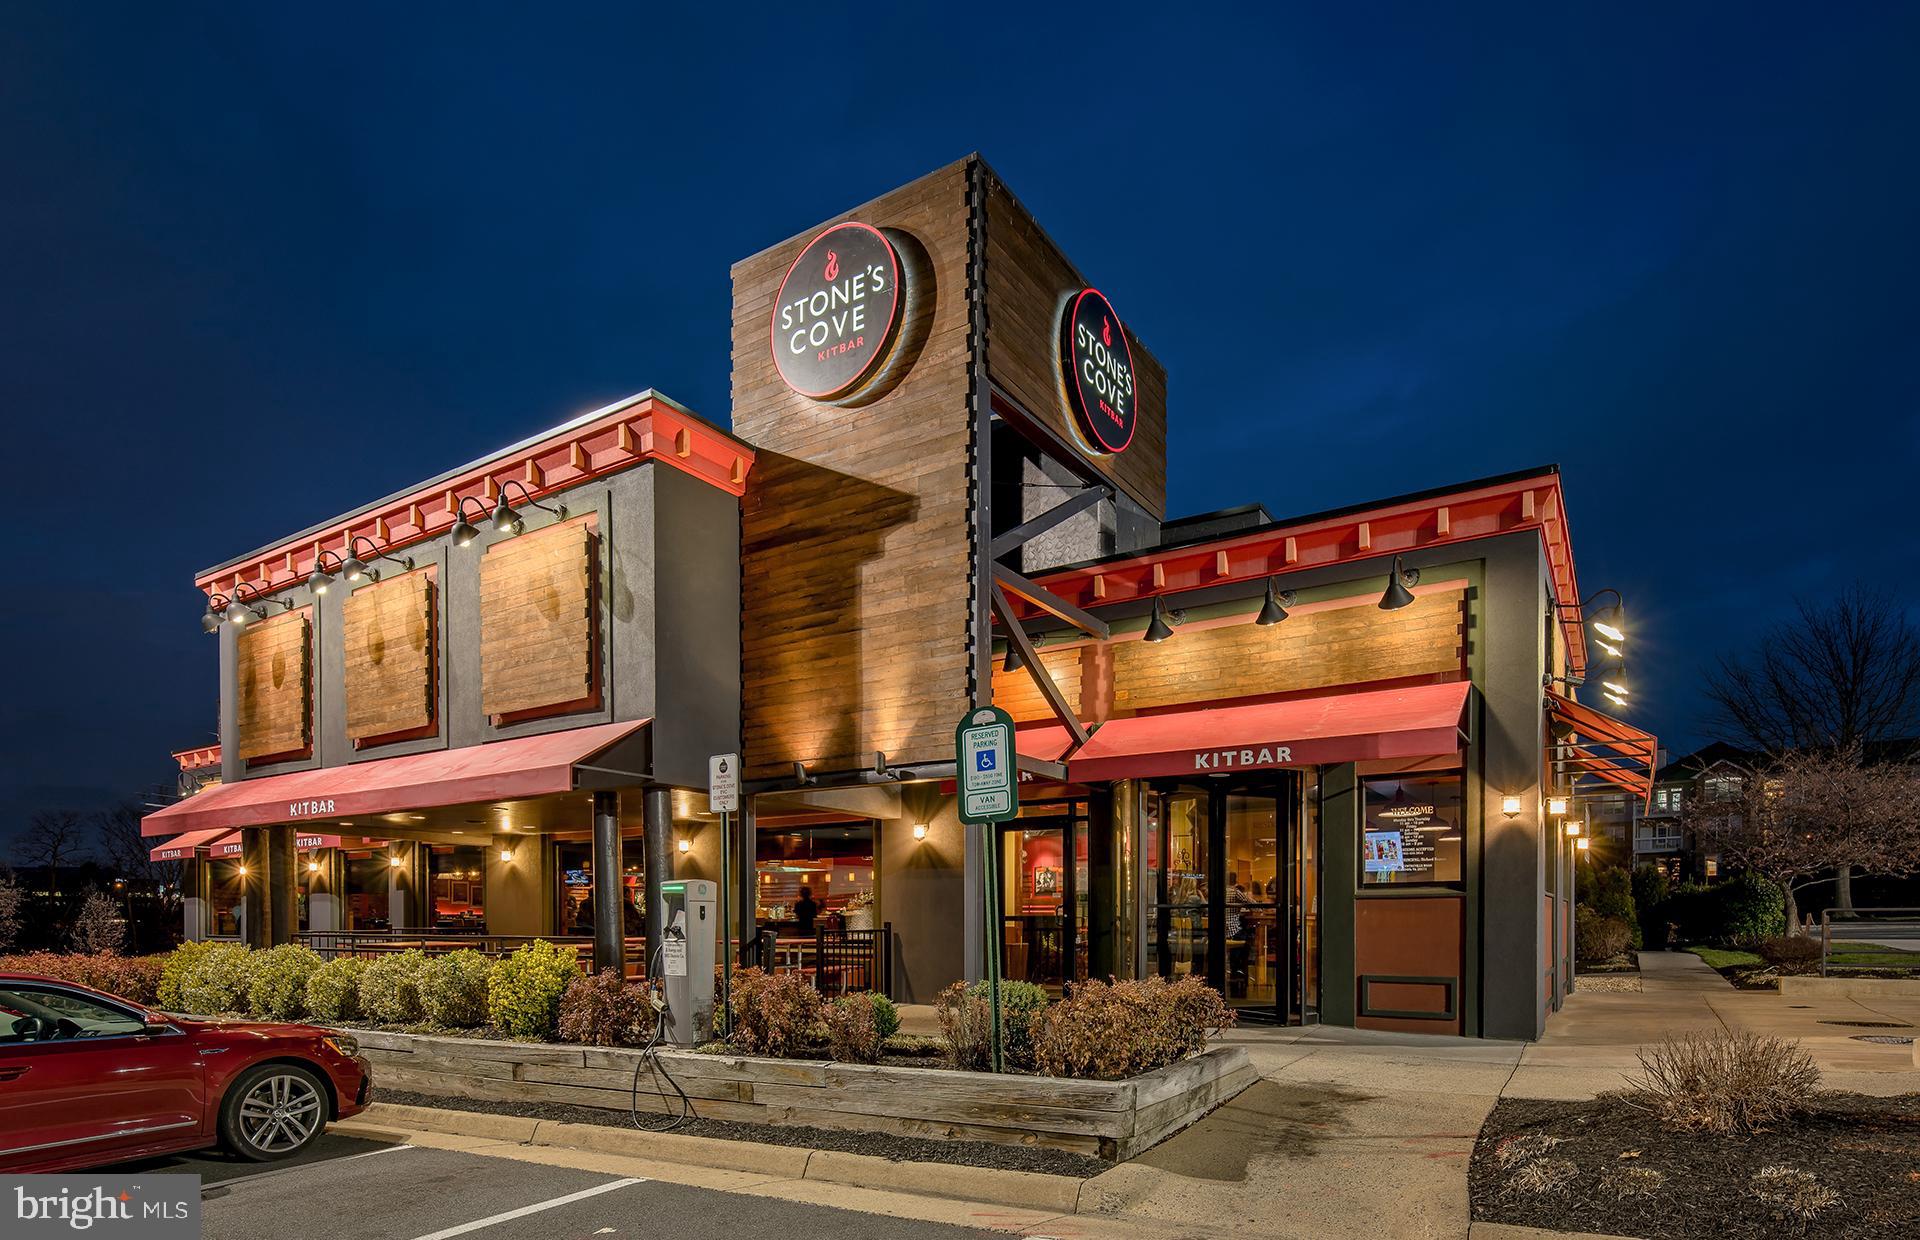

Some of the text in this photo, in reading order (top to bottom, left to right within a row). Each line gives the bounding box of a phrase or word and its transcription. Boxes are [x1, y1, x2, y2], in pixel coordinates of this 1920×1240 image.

[781, 264, 885, 330] STONE'S
[790, 304, 865, 355] COVE
[817, 335, 865, 362] KITBAR
[1078, 323, 1132, 396] STONE'S
[1084, 358, 1124, 415] COVE
[1099, 399, 1124, 429] KITBAR
[971, 730, 999, 741] RESERVED
[973, 739, 998, 749] PARKING
[1194, 746, 1292, 769] KITBAR
[979, 795, 996, 804] VAN
[289, 799, 335, 817] KITBAR
[975, 803, 1001, 811] ACCESSIBLE
[1391, 806, 1434, 817] WELCOME
[223, 844, 243, 854] KITBA
[295, 837, 323, 848] KITBAR
[161, 849, 182, 859] KITBAR
